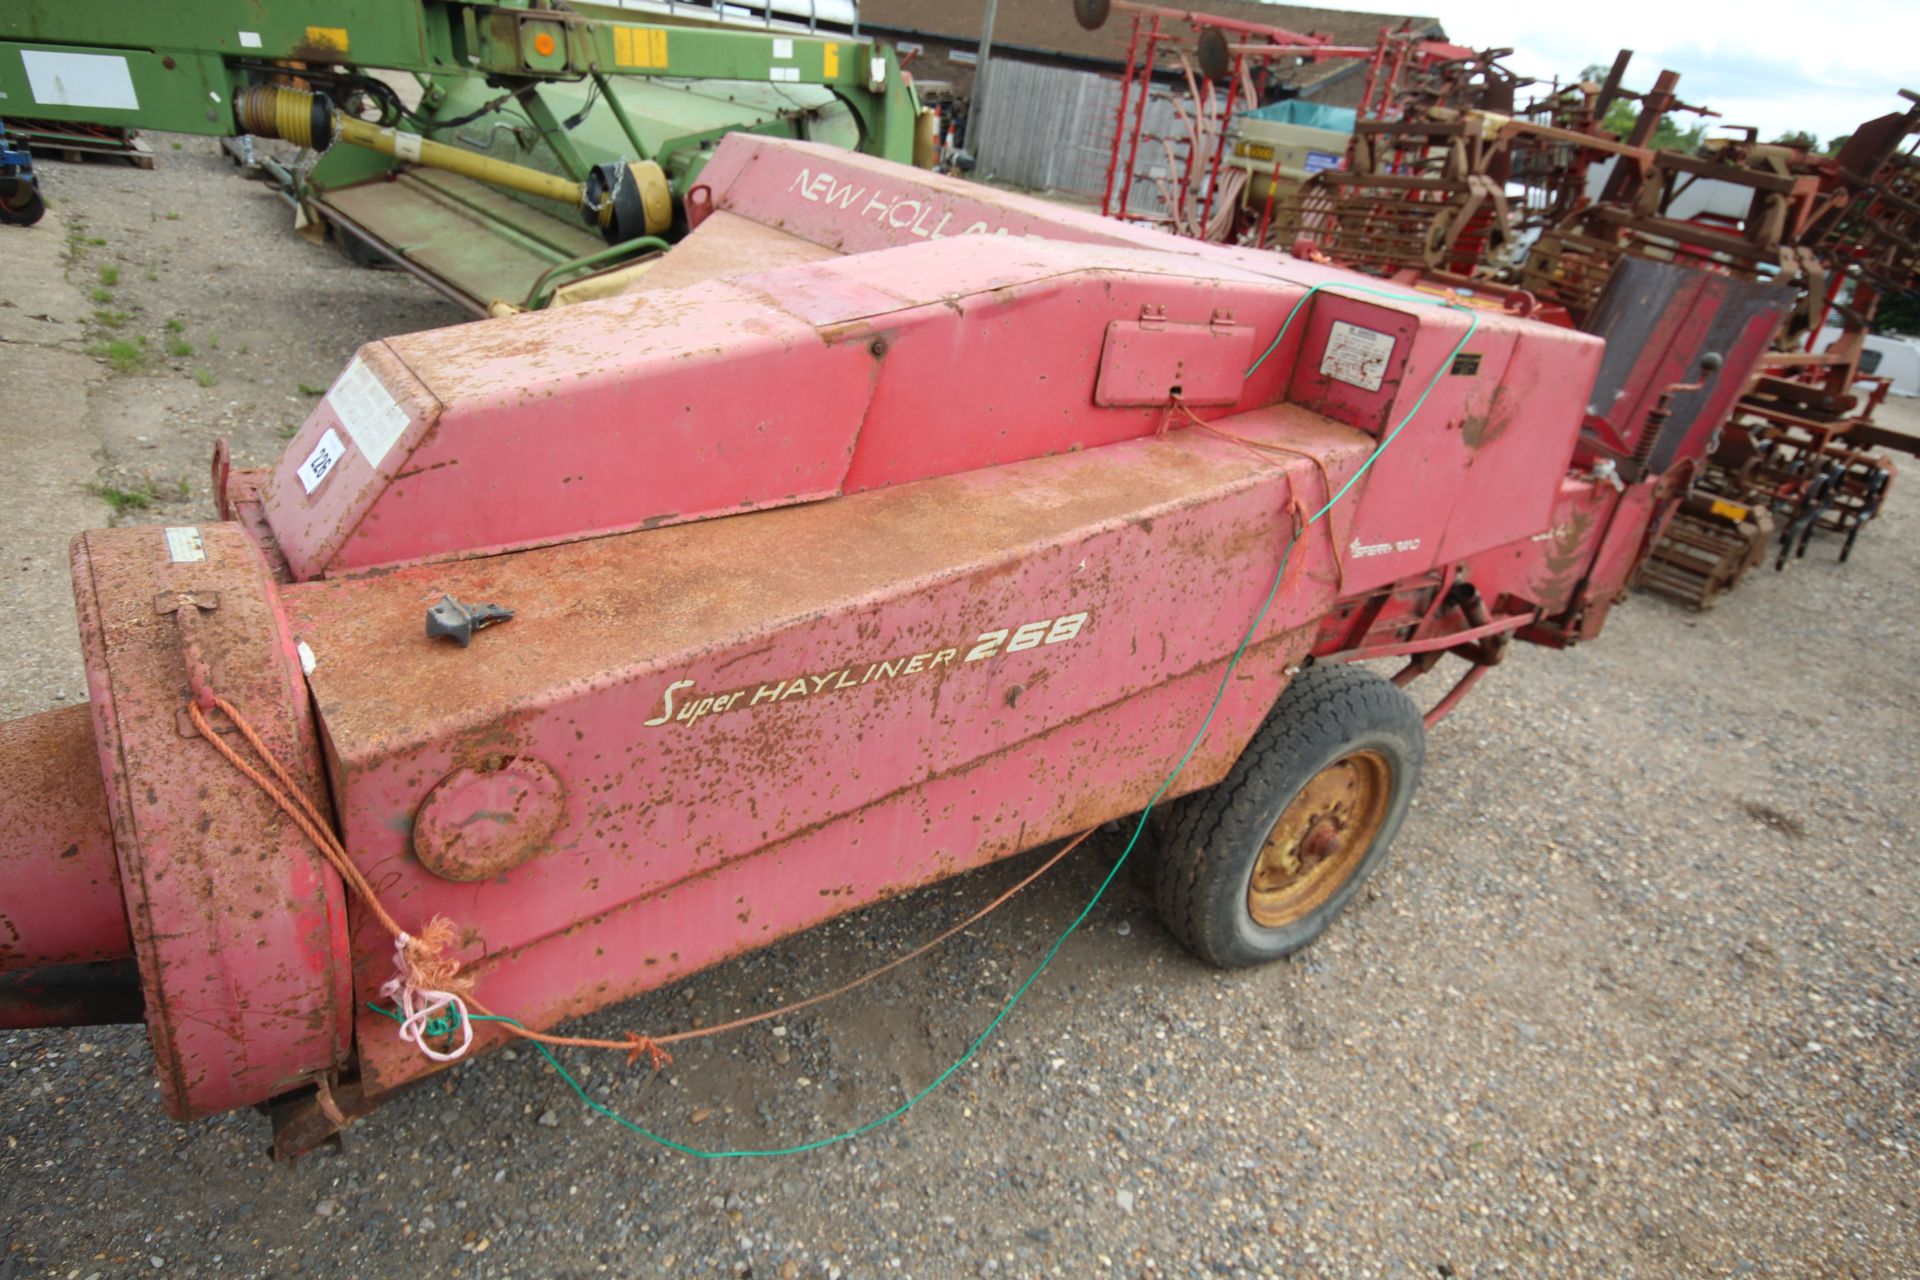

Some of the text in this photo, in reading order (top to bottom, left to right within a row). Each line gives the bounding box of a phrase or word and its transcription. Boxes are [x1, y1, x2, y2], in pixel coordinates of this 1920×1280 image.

[788, 168, 1043, 240] NEW HOLL
[311, 448, 332, 479] 226
[749, 648, 957, 706] HAYLINER
[964, 612, 1089, 663] 268
